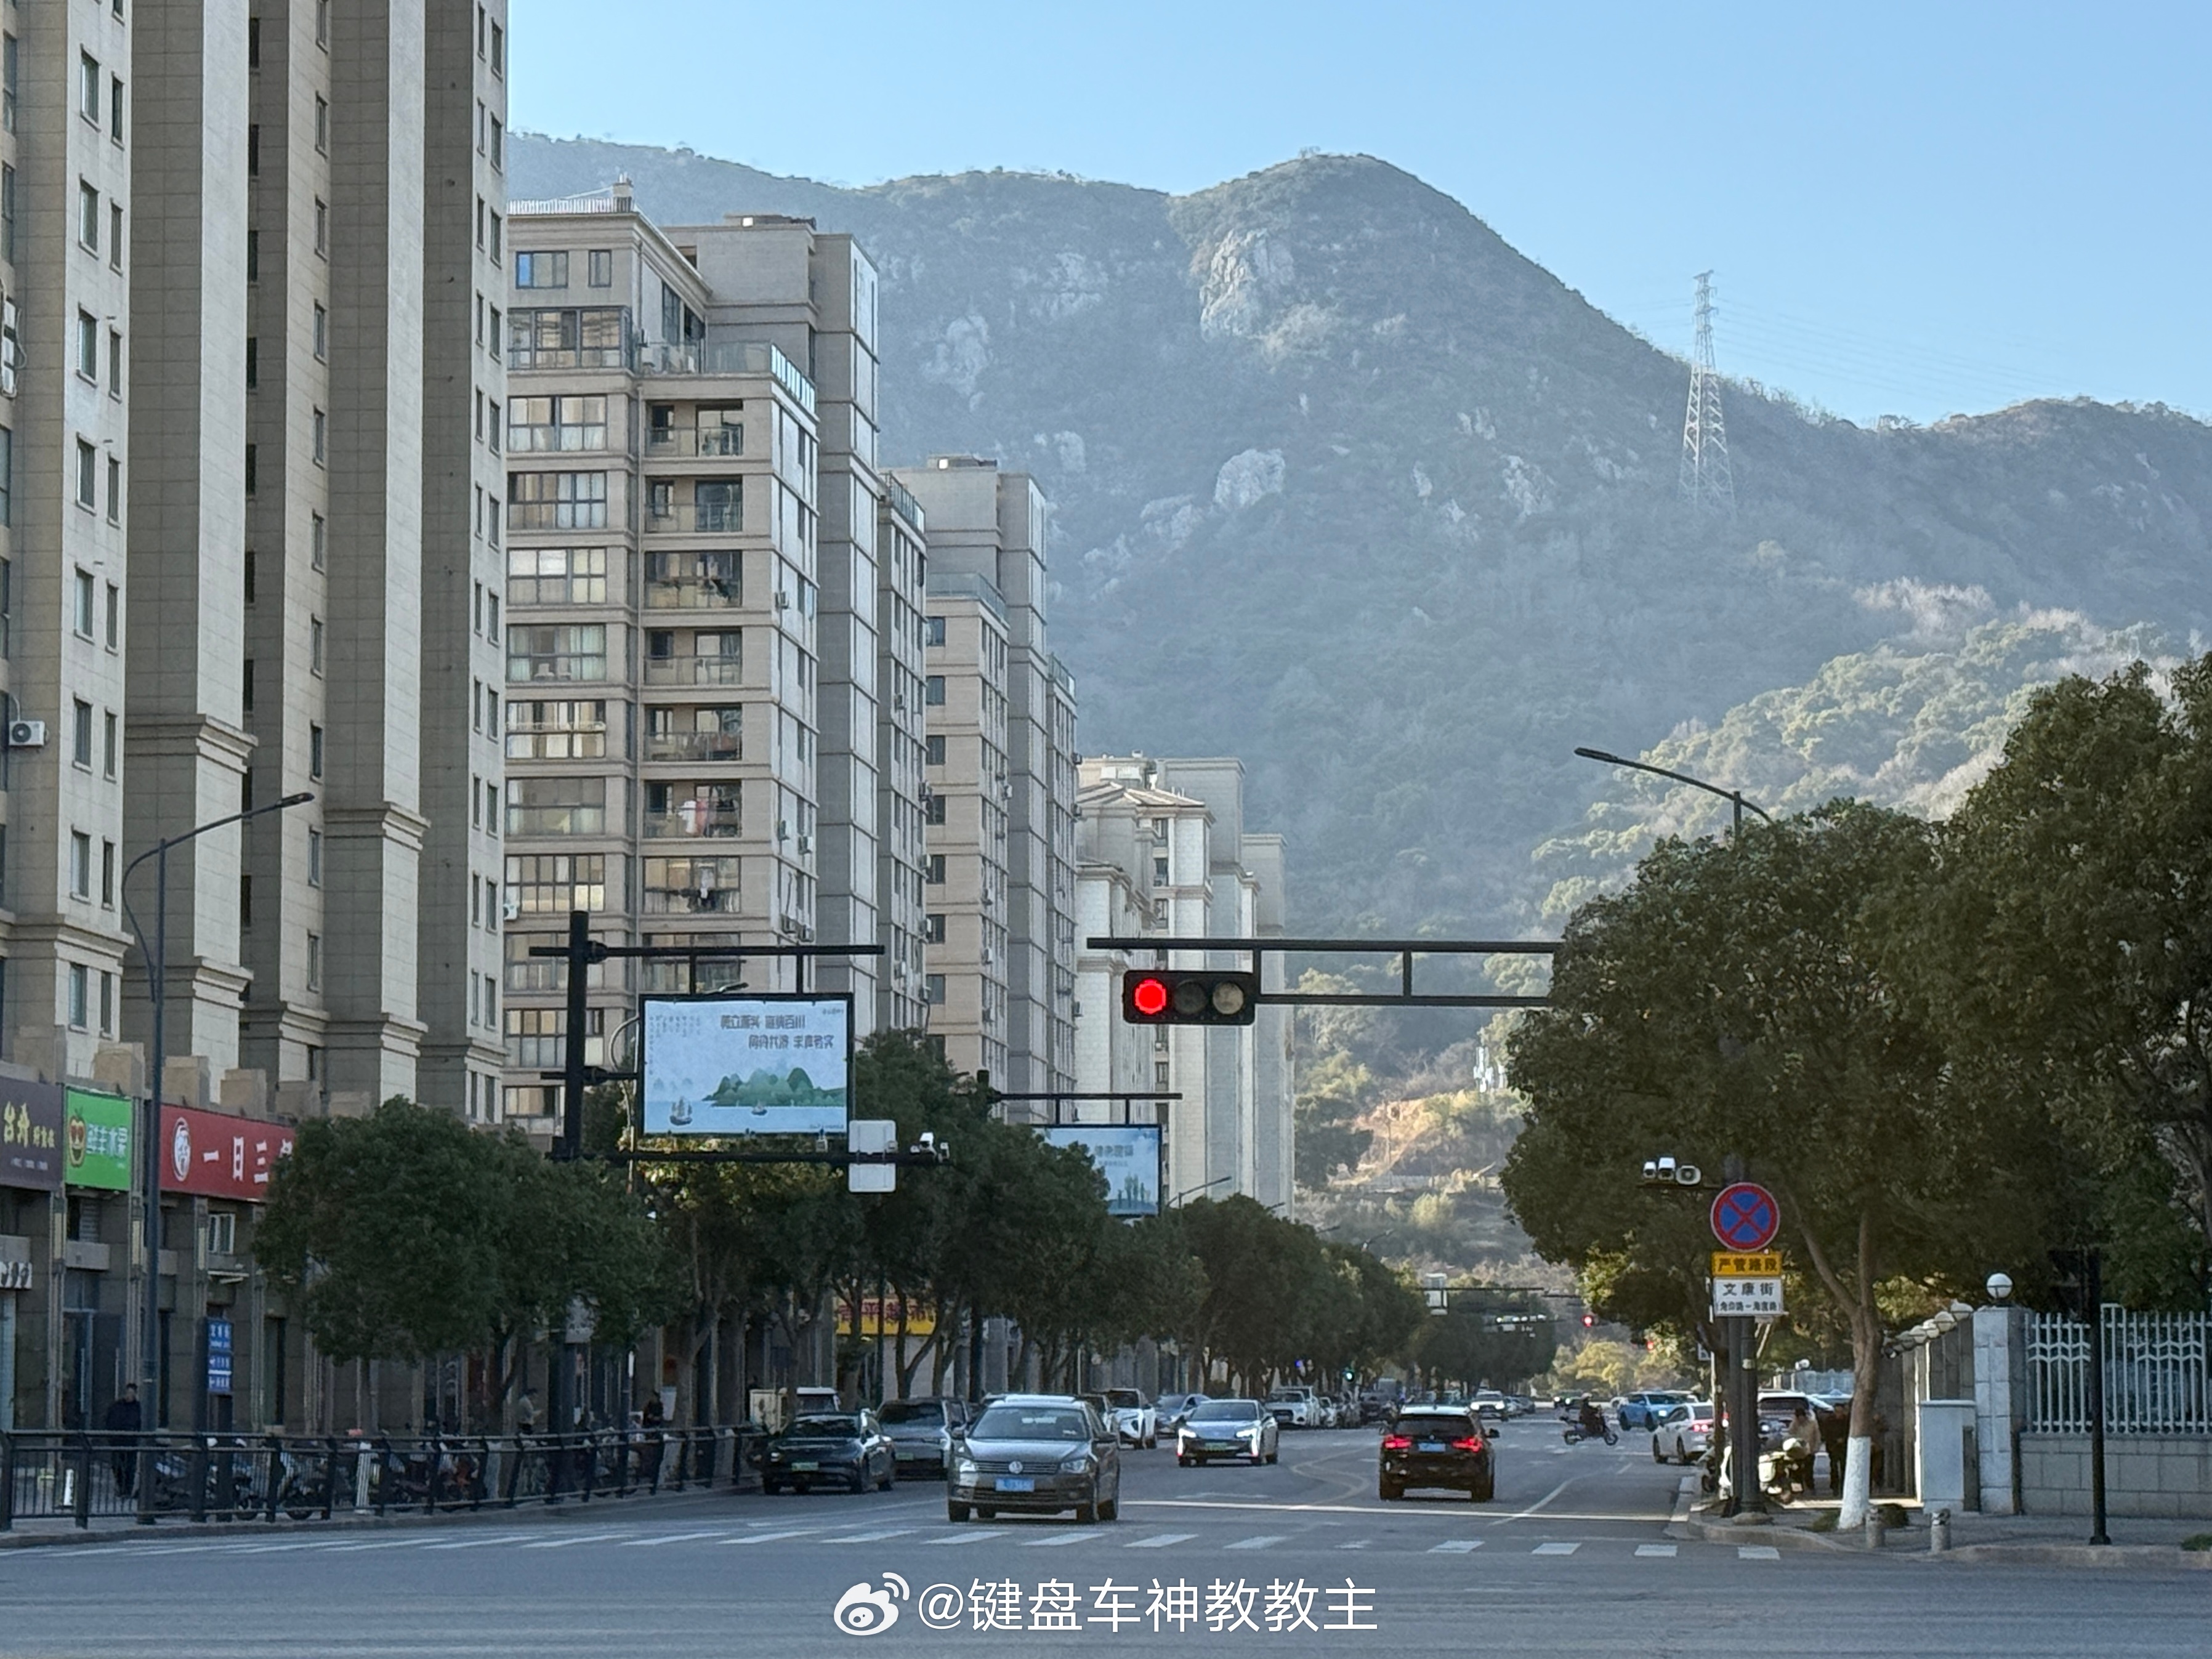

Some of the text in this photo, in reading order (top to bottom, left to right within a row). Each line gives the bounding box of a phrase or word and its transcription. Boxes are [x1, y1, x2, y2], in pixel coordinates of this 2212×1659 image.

[1718, 1257, 1777, 1272] 严管路段
[1722, 1283, 1774, 1296] 文康街
